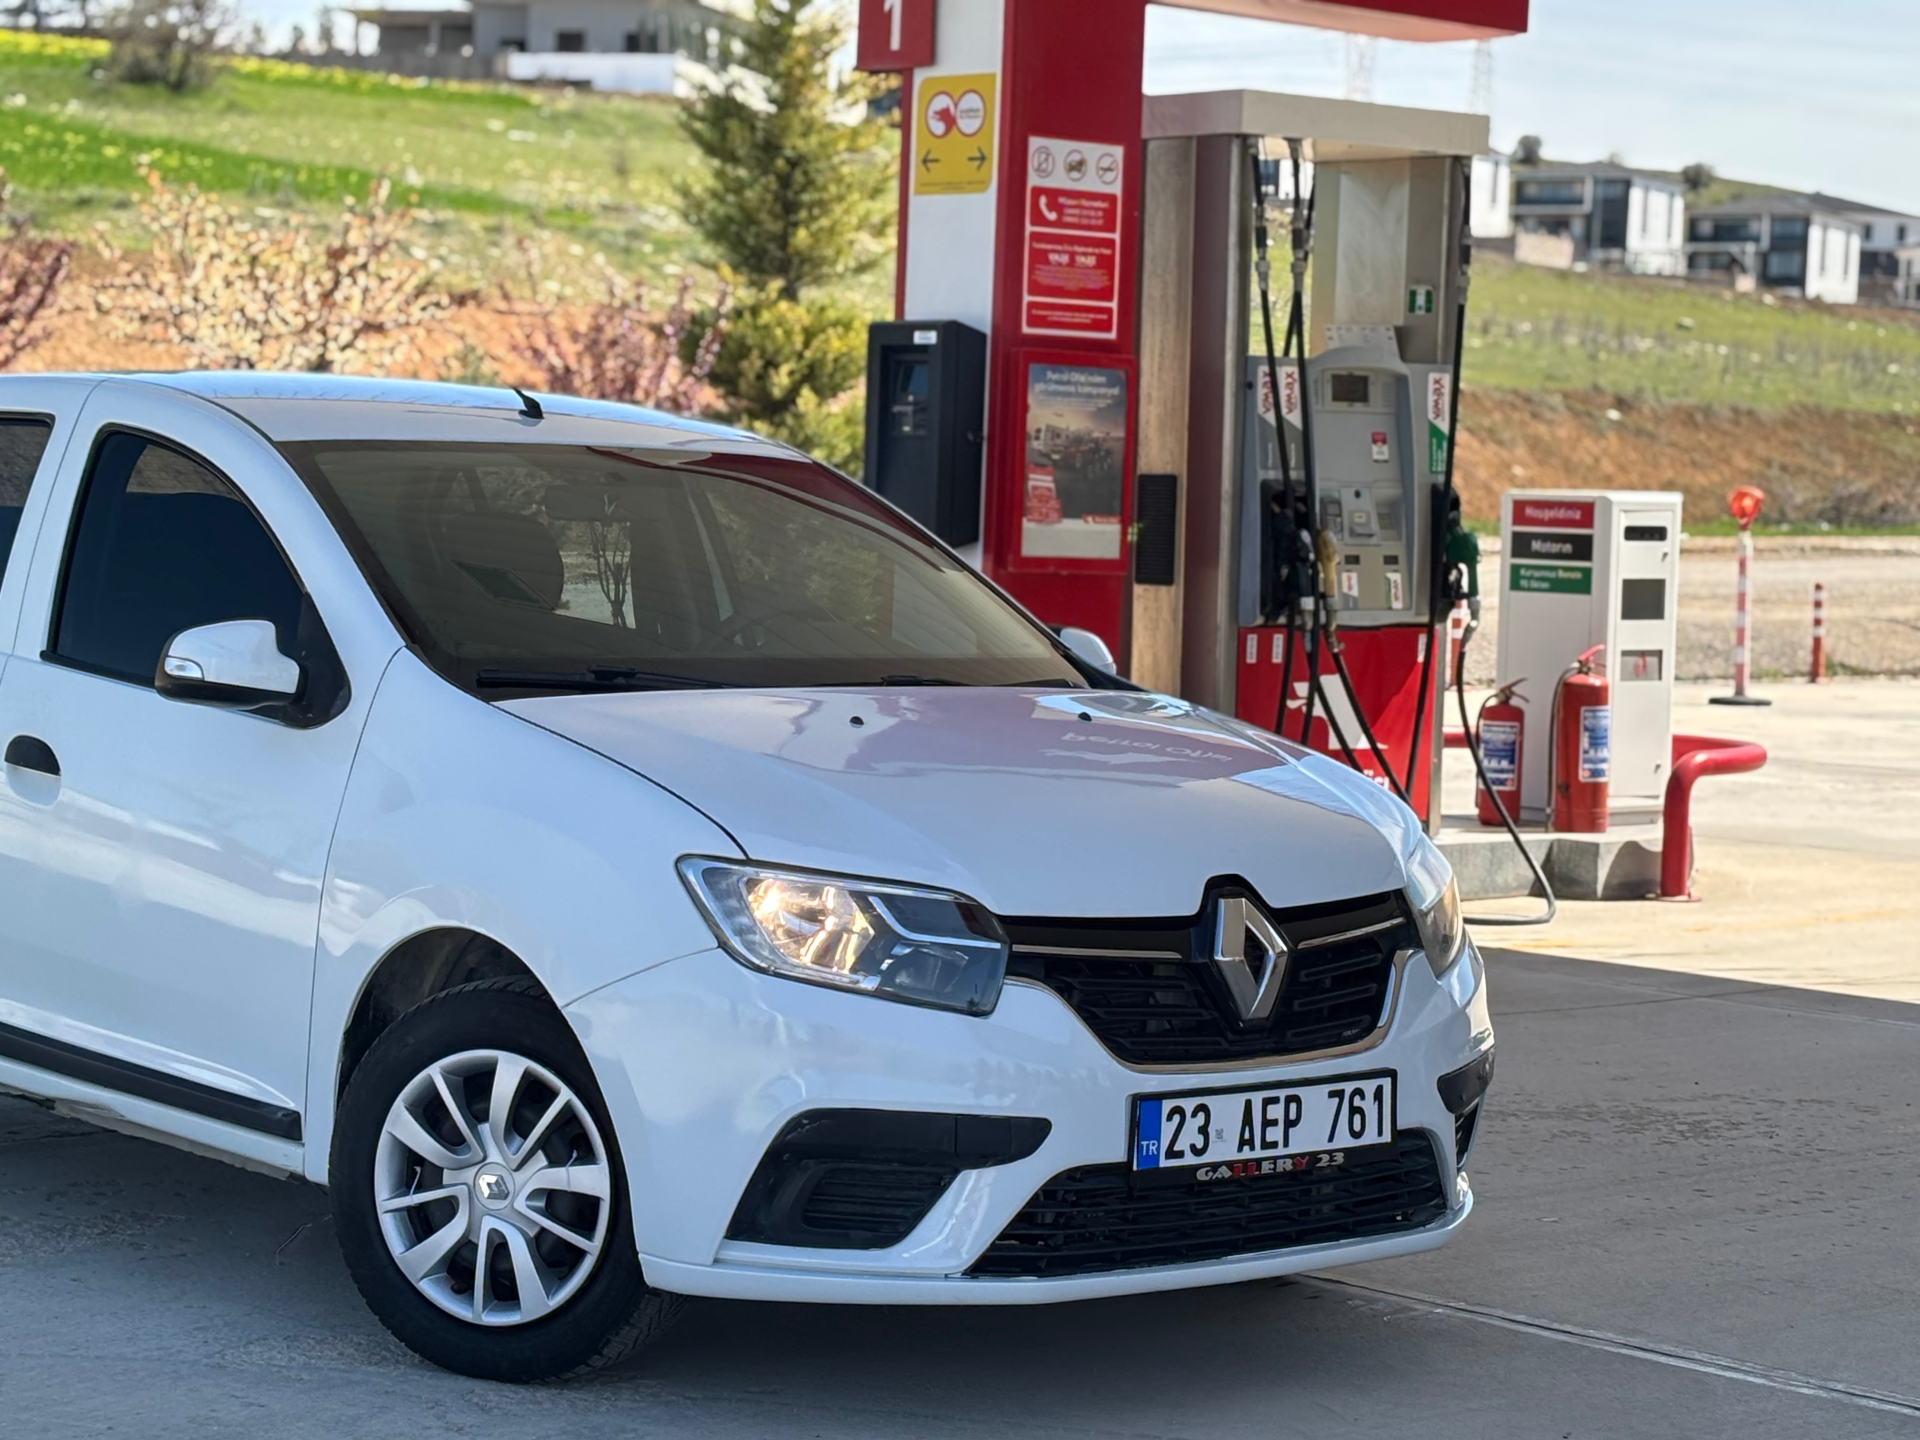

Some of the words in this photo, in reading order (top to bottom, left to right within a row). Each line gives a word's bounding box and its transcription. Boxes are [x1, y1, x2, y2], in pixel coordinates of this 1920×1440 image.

[884, 0, 902, 51] 1
[1141, 1140, 1158, 1156] TR
[1164, 1103, 1211, 1160] 23
[1237, 1094, 1302, 1153] AEP
[1327, 1084, 1384, 1143] 761
[1196, 1155, 1309, 1181] GALLERY
[1315, 1152, 1345, 1168] 23
